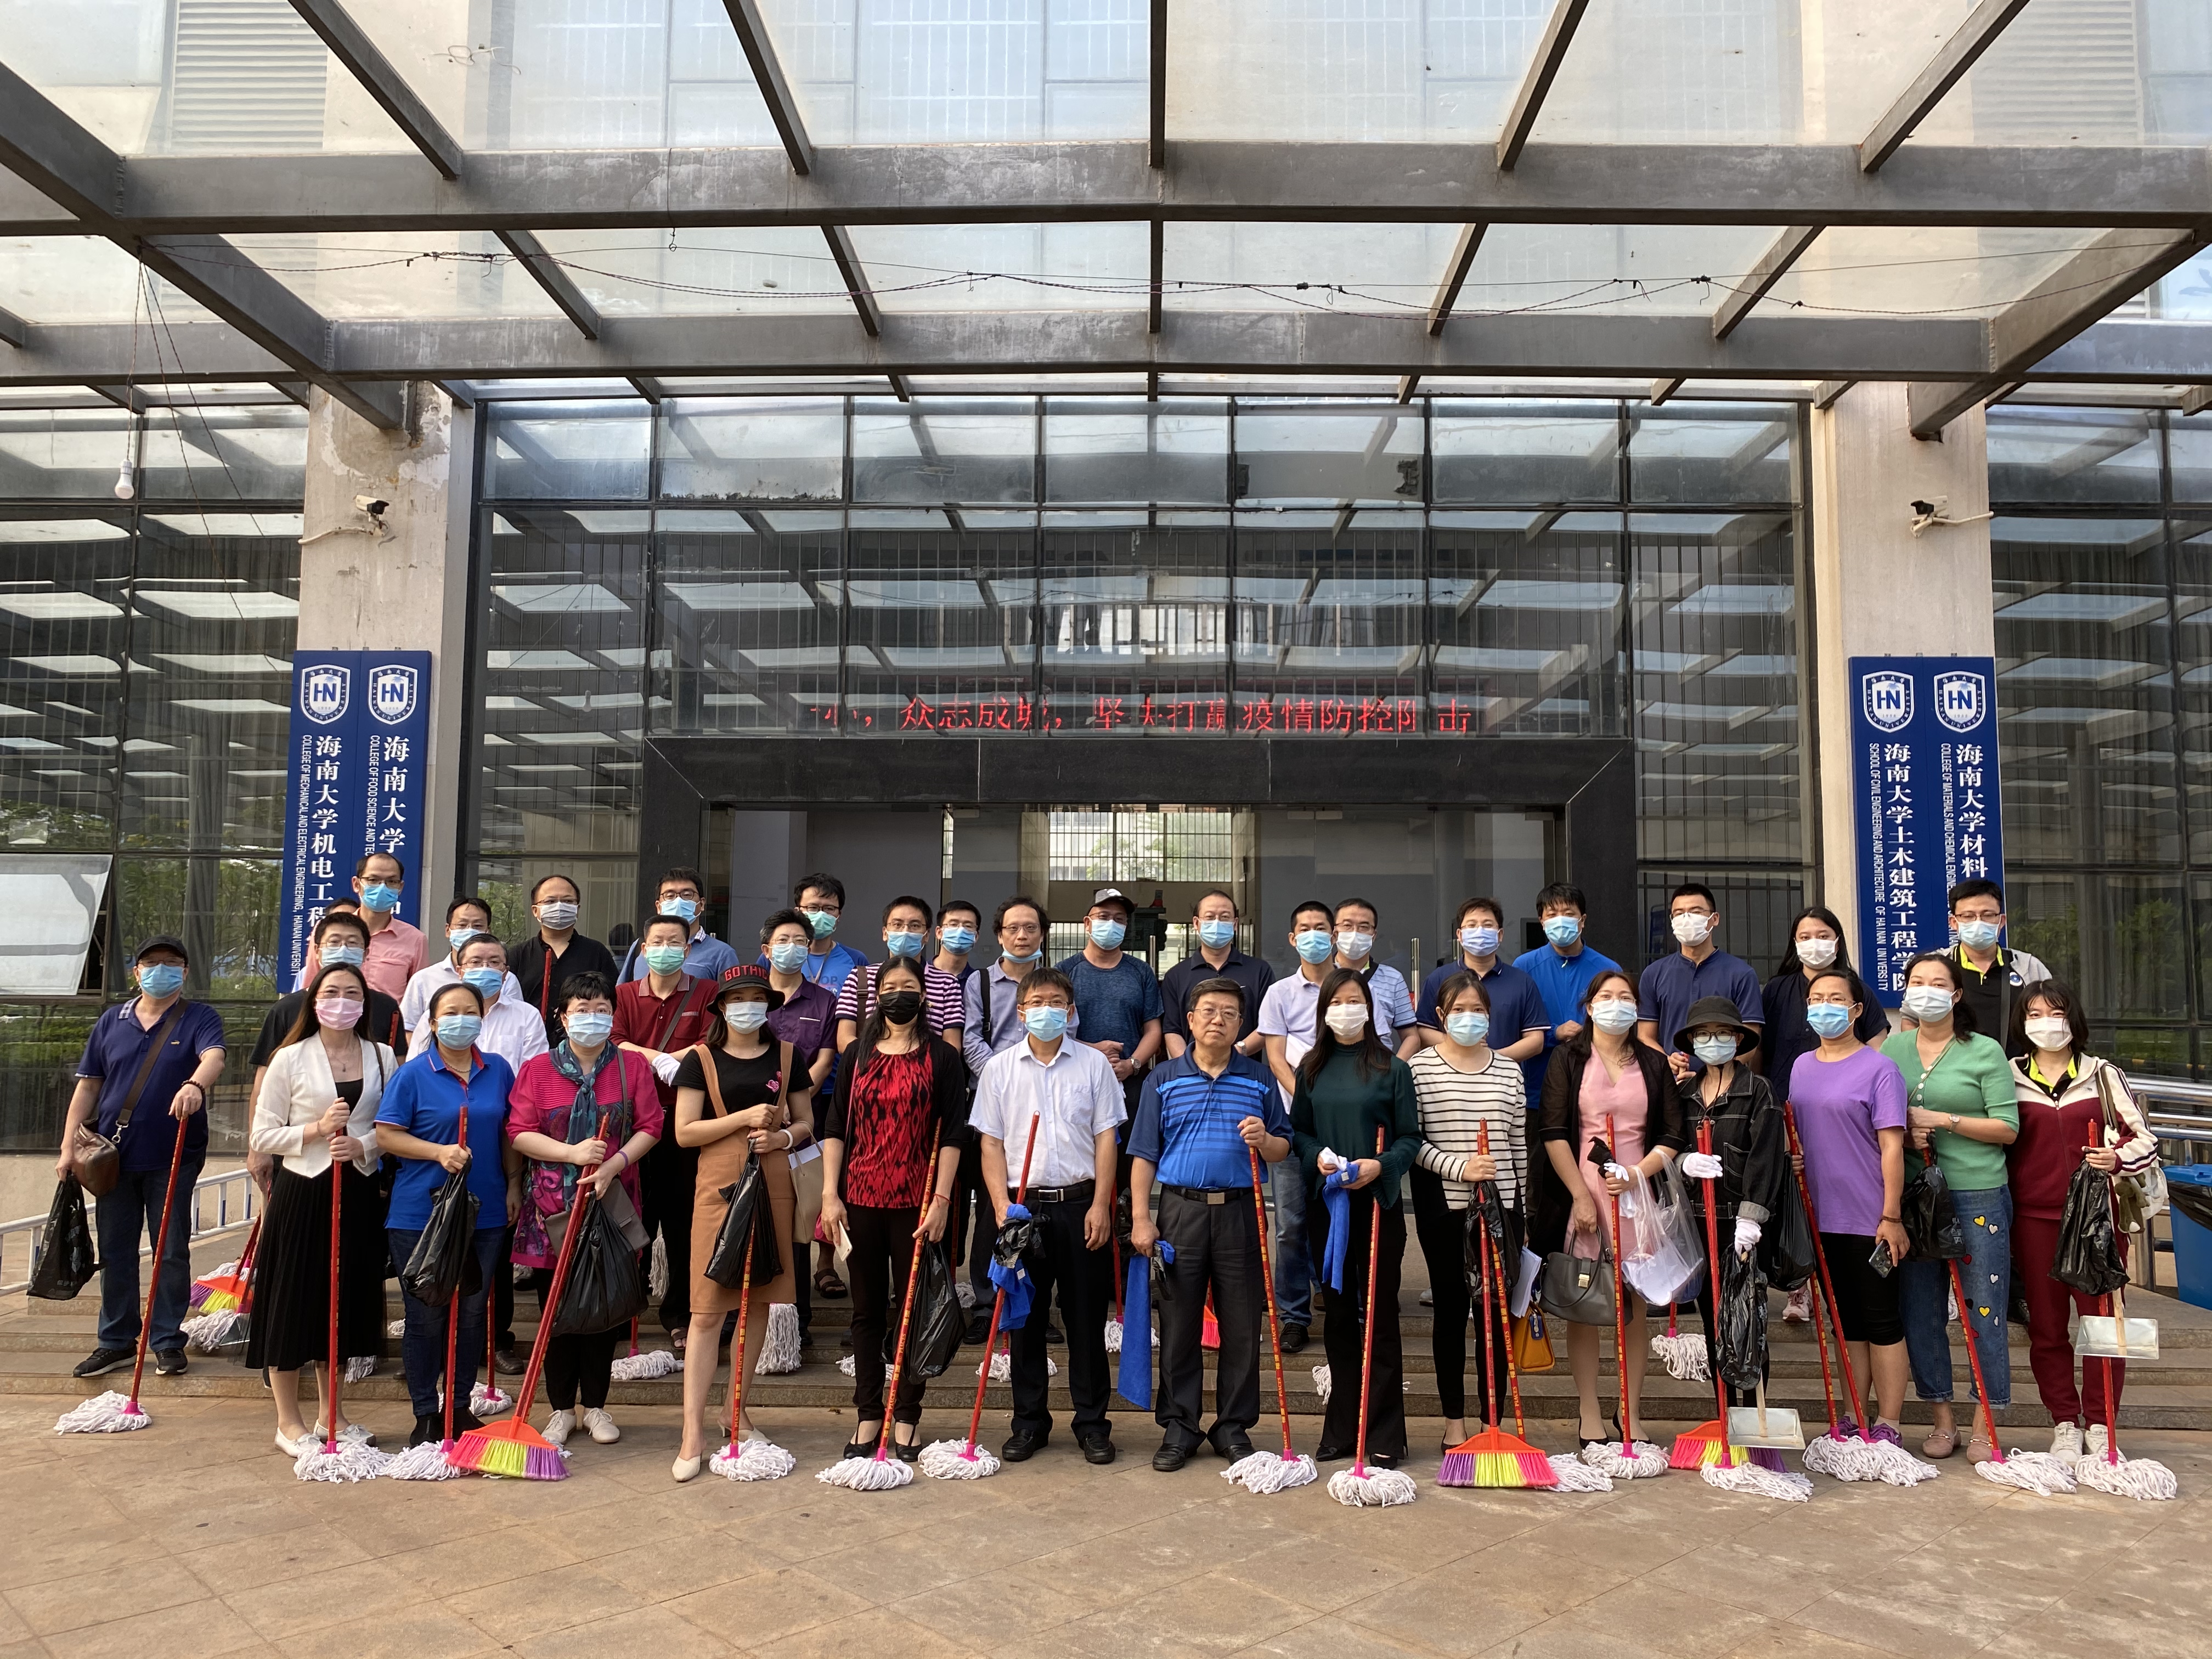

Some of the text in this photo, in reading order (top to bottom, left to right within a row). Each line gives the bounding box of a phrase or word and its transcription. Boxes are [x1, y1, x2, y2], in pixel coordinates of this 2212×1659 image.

[302, 735, 312, 764] COLLEGE
[369, 735, 381, 766] COLLEGE
[1941, 743, 1952, 772] COLLEGE
[301, 764, 311, 773] OF
[368, 767, 380, 777] OF
[1942, 772, 1953, 782] OF
[299, 774, 310, 814] MECHANICAL
[368, 777, 379, 797] FOOD
[1943, 782, 1954, 817] MATERIALS
[298, 814, 308, 827] AND
[366, 798, 378, 827] SCIENCE
[1944, 818, 1954, 832] AND
[296, 829, 308, 866] ELECTRICAL
[305, 735, 342, 945] 海南大学机电工程
[365, 828, 376, 842] AND
[1944, 832, 1956, 864] CHEMICAL
[1870, 743, 1888, 991] SCHOOL OF CIVIL ENGINEERING AND ARCHITECTURE OF HAINAN UNIVERSITY
[292, 915, 303, 939] HAINAN
[724, 965, 768, 981] GOTHIC
